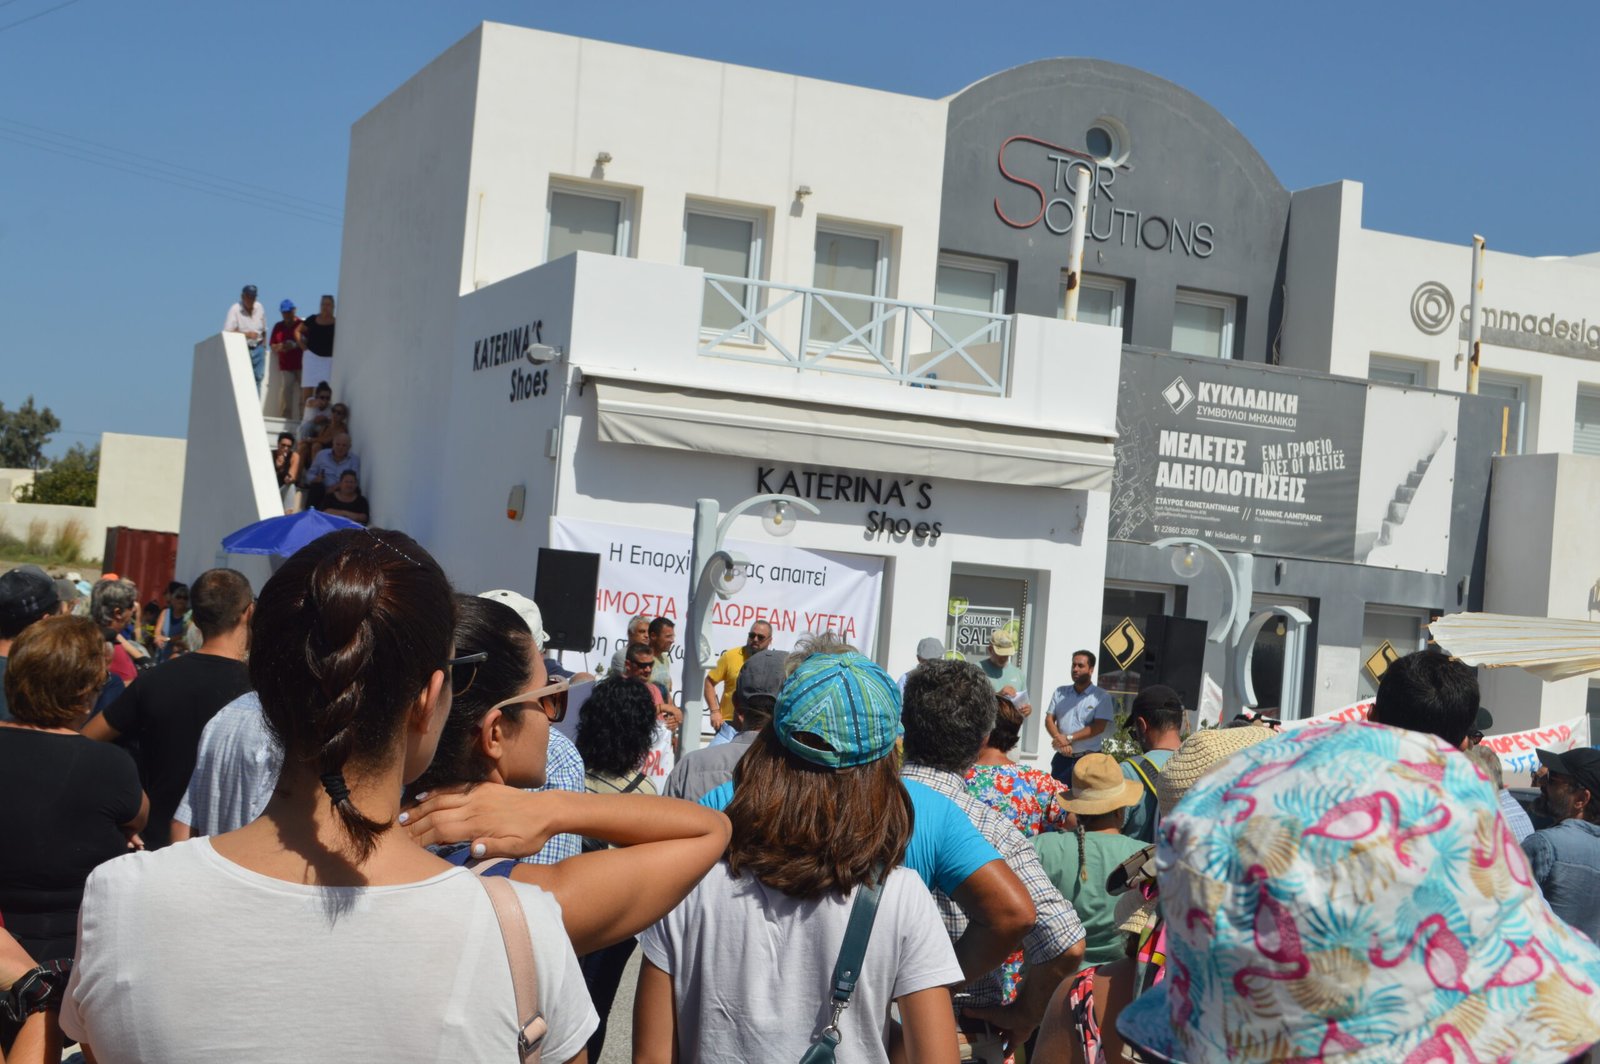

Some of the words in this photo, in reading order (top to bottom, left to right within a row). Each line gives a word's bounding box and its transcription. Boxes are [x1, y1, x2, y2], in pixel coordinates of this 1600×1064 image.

[509, 367, 549, 403] Shoes
[1198, 381, 1299, 415] ΚΥΚΛΑΔΙΚΗ
[1196, 405, 1247, 421] ΣΥΜΒΟΥΛΟΙ
[1248, 412, 1297, 428] ΜΗΧΑΝΙΚΟΙ
[1158, 429, 1247, 466] ΜΕΛΕΤΕΣ
[1261, 443, 1283, 461] ΕΝΑ
[1262, 459, 1289, 476] ΟΛΕΣ
[1308, 453, 1346, 473] ΑΔΕΙΕΣ
[756, 466, 933, 510] KATERINA'S
[1155, 461, 1307, 503] ΑΔΕΙΟΔΟΤΗΣΕΙΣ
[867, 510, 943, 539] Shoes
[609, 542, 623, 562] Η
[630, 545, 692, 575] Επαρχί
[770, 565, 827, 587] απαιτεί
[963, 615, 1001, 626] SUMMER
[960, 627, 997, 646] SAL
